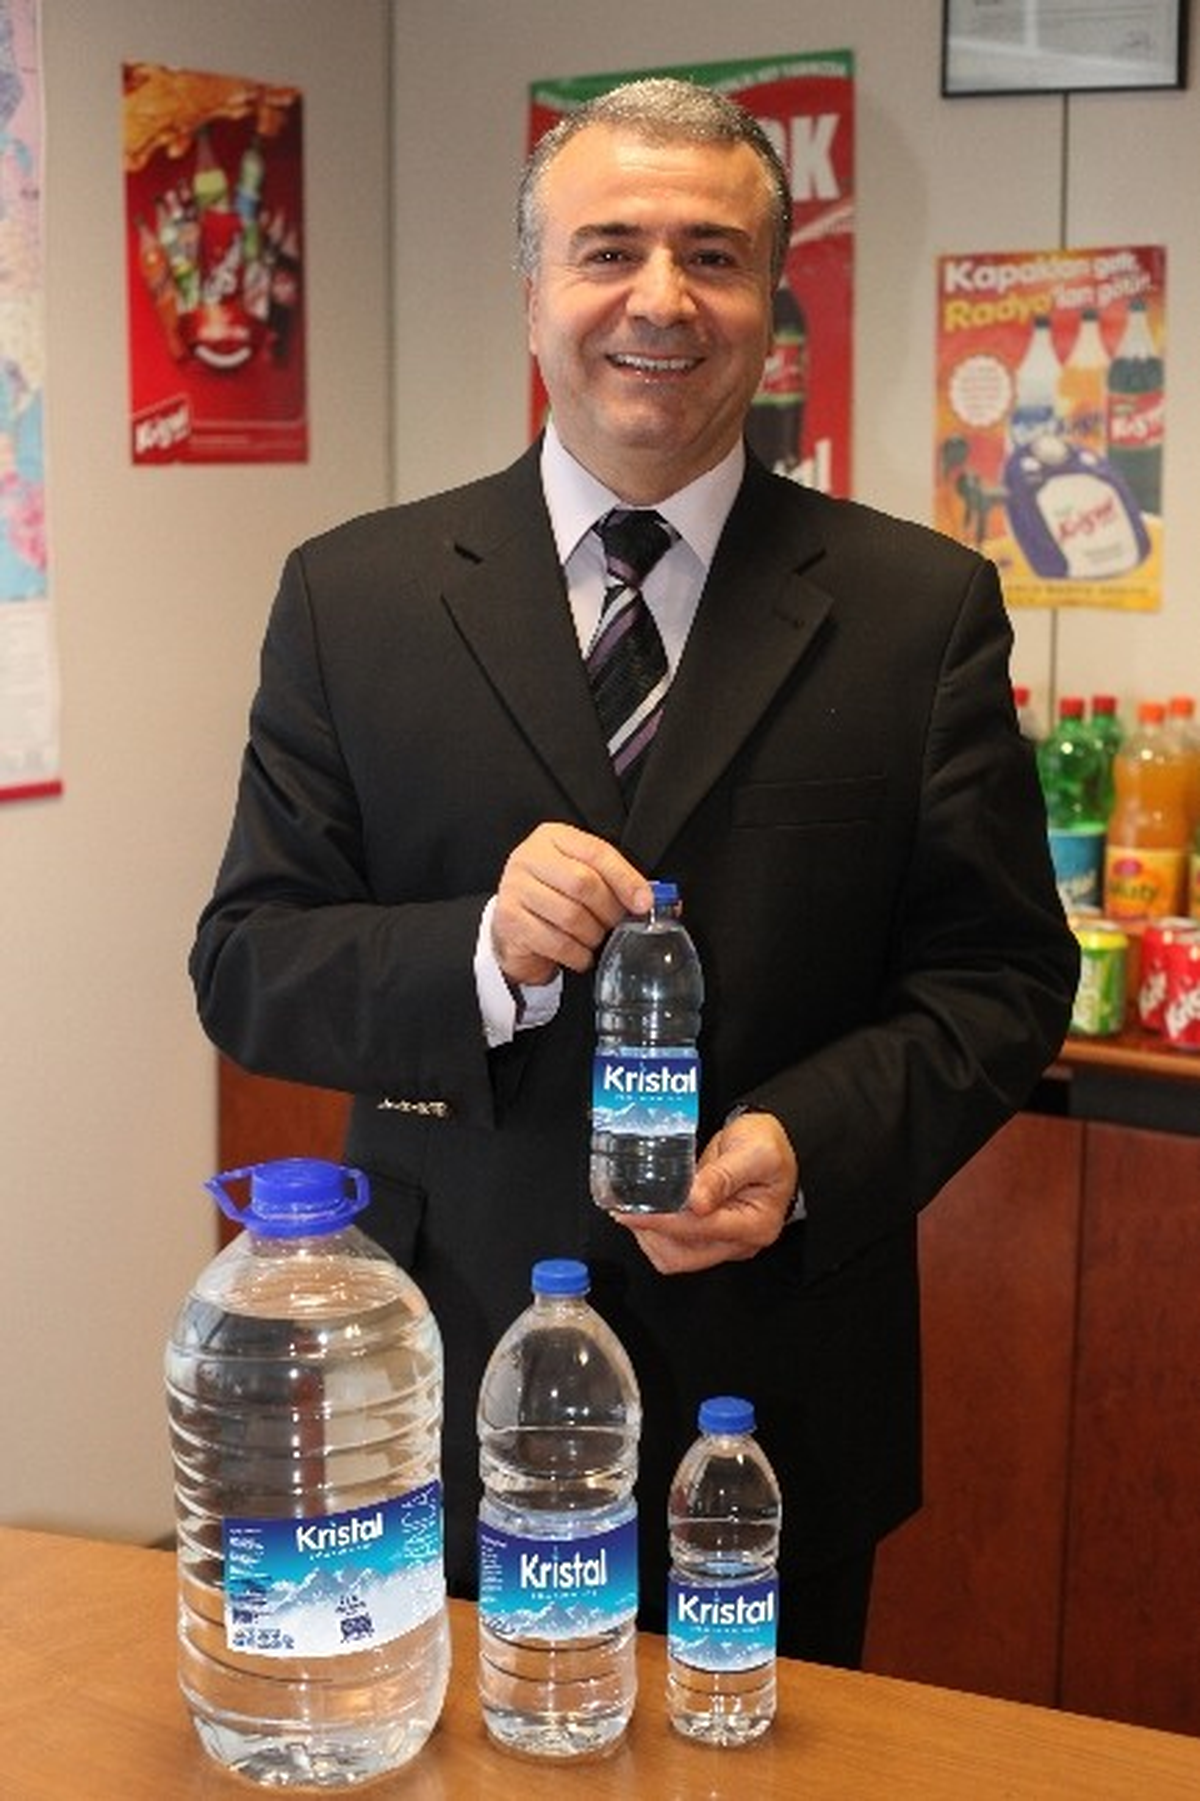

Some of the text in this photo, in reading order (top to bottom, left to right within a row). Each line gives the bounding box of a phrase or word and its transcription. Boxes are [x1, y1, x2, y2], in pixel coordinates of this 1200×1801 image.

[604, 1064, 697, 1093] Kristal
[296, 1512, 384, 1552] Kristal
[520, 1548, 607, 1588] Kristal
[678, 1590, 774, 1624] Kristal
